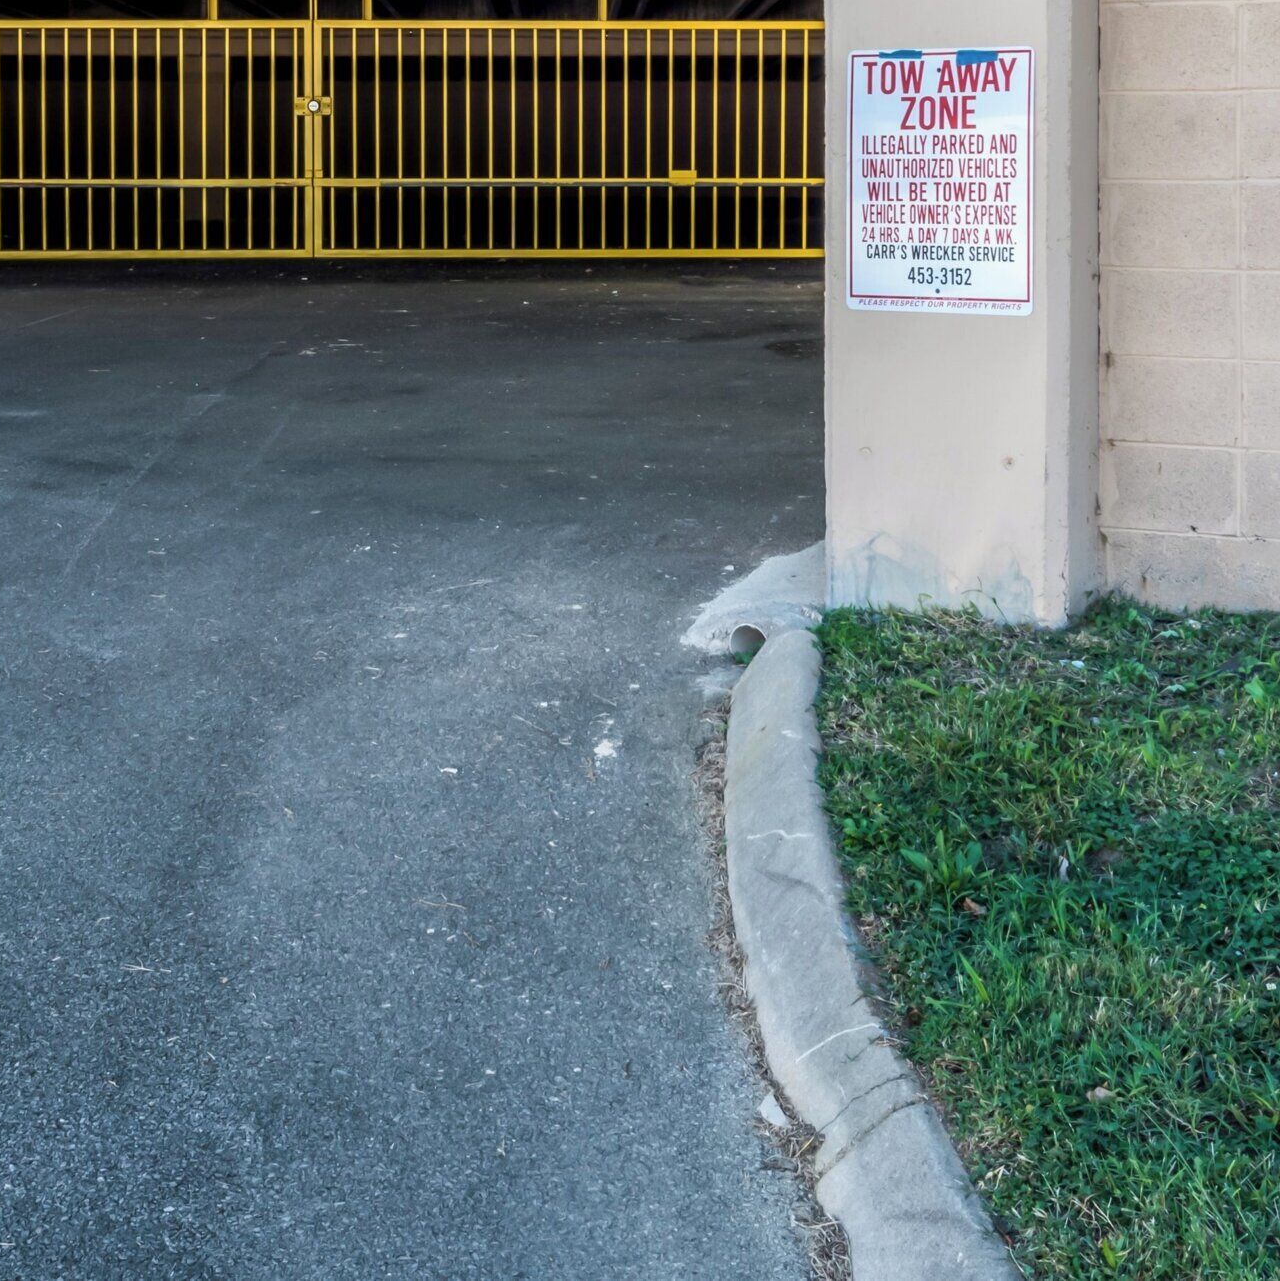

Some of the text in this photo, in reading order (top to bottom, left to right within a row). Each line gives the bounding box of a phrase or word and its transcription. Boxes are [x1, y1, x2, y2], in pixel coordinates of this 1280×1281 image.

[863, 58, 1017, 95] TOW AWAY
[900, 95, 977, 131] ZONE
[862, 134, 1017, 155] ILLEGALLY PARKED AND
[862, 158, 1017, 179] UNAUTHORIZED VEHICLES
[867, 182, 1011, 202] WILL BE TOWED AT
[862, 204, 1017, 226] VEHICLE OWNER'S EXPENSE
[862, 227, 1017, 245] 24 HRS. A DAY 7 DAYS A WK.
[866, 244, 1015, 262] CARR'S WRECKER SERVICE
[908, 267, 972, 286] 453-3152
[858, 298, 1022, 310] PLEASE RESPECT OUR PROPERTY RIGHTS
